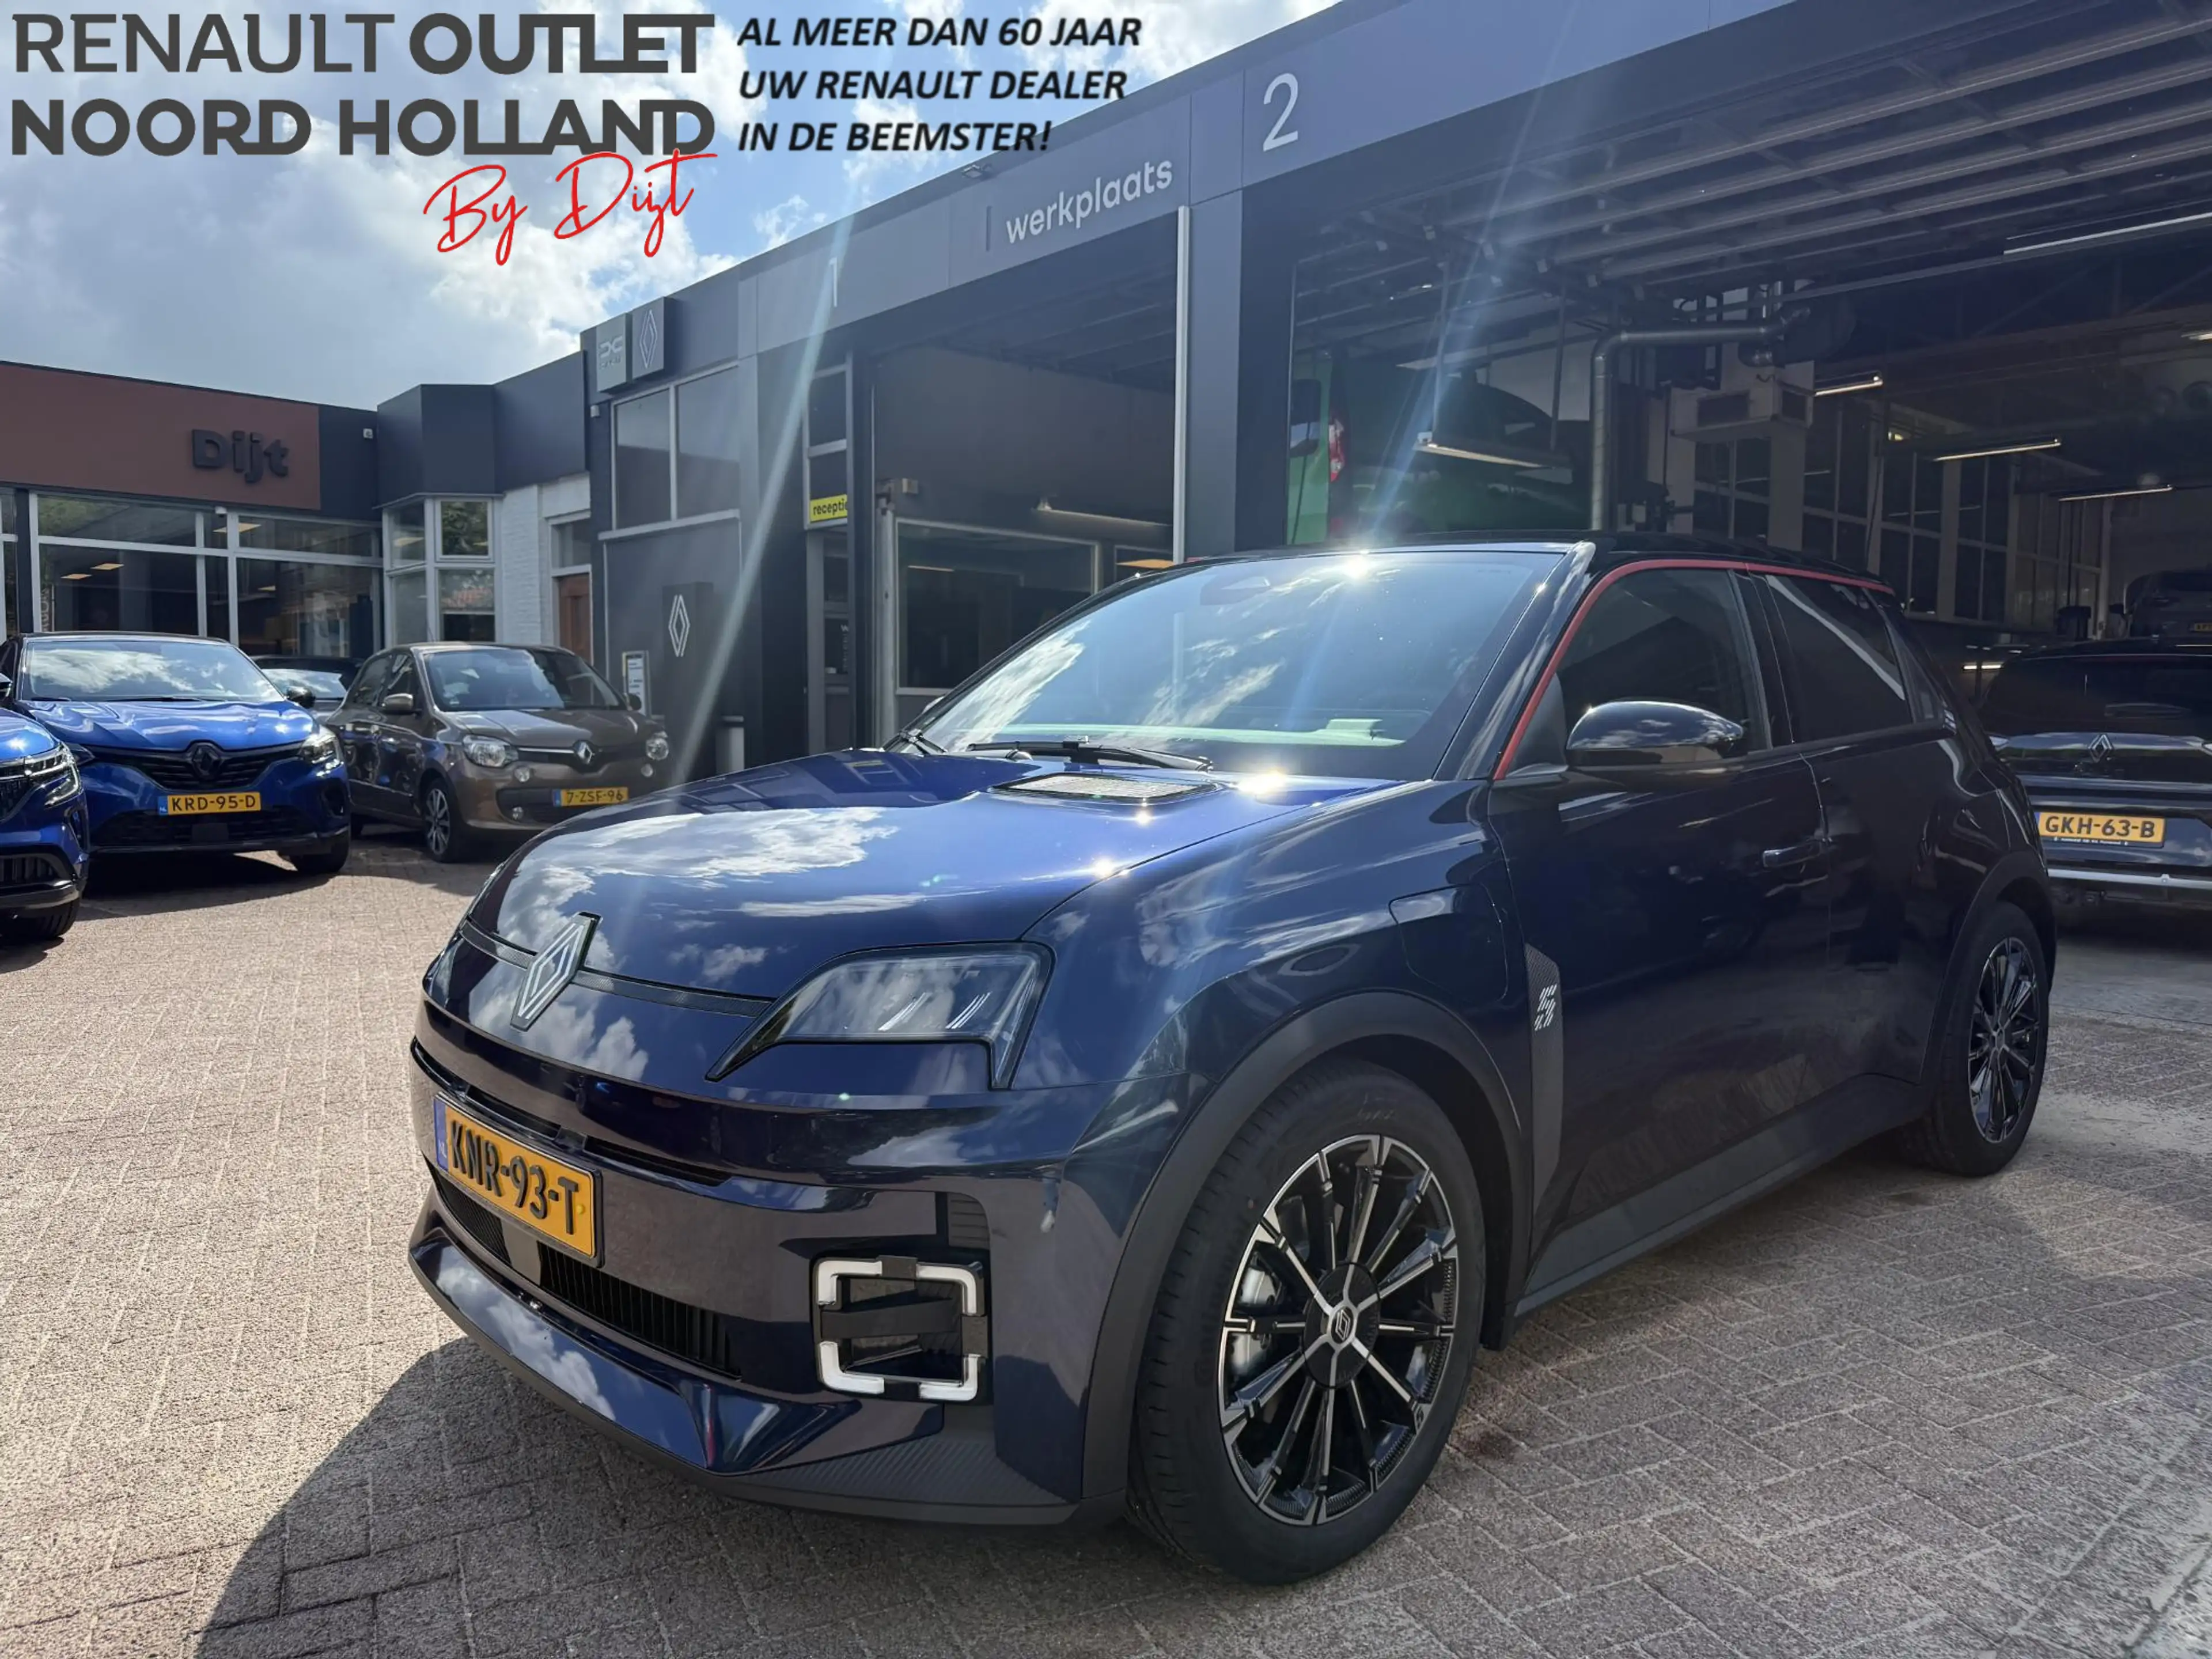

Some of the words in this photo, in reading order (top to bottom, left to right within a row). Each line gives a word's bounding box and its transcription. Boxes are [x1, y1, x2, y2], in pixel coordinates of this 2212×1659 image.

[1263, 73, 1298, 152] 2
[1005, 160, 1173, 244] werkplaats
[829, 257, 838, 307] 1
[191, 429, 290, 484] Dijt
[172, 794, 256, 812] KRD-95-D
[566, 789, 623, 804] 7-ZSF-96
[2046, 816, 2155, 838] GKH-63-B
[452, 1120, 579, 1235] KNR-93-T
